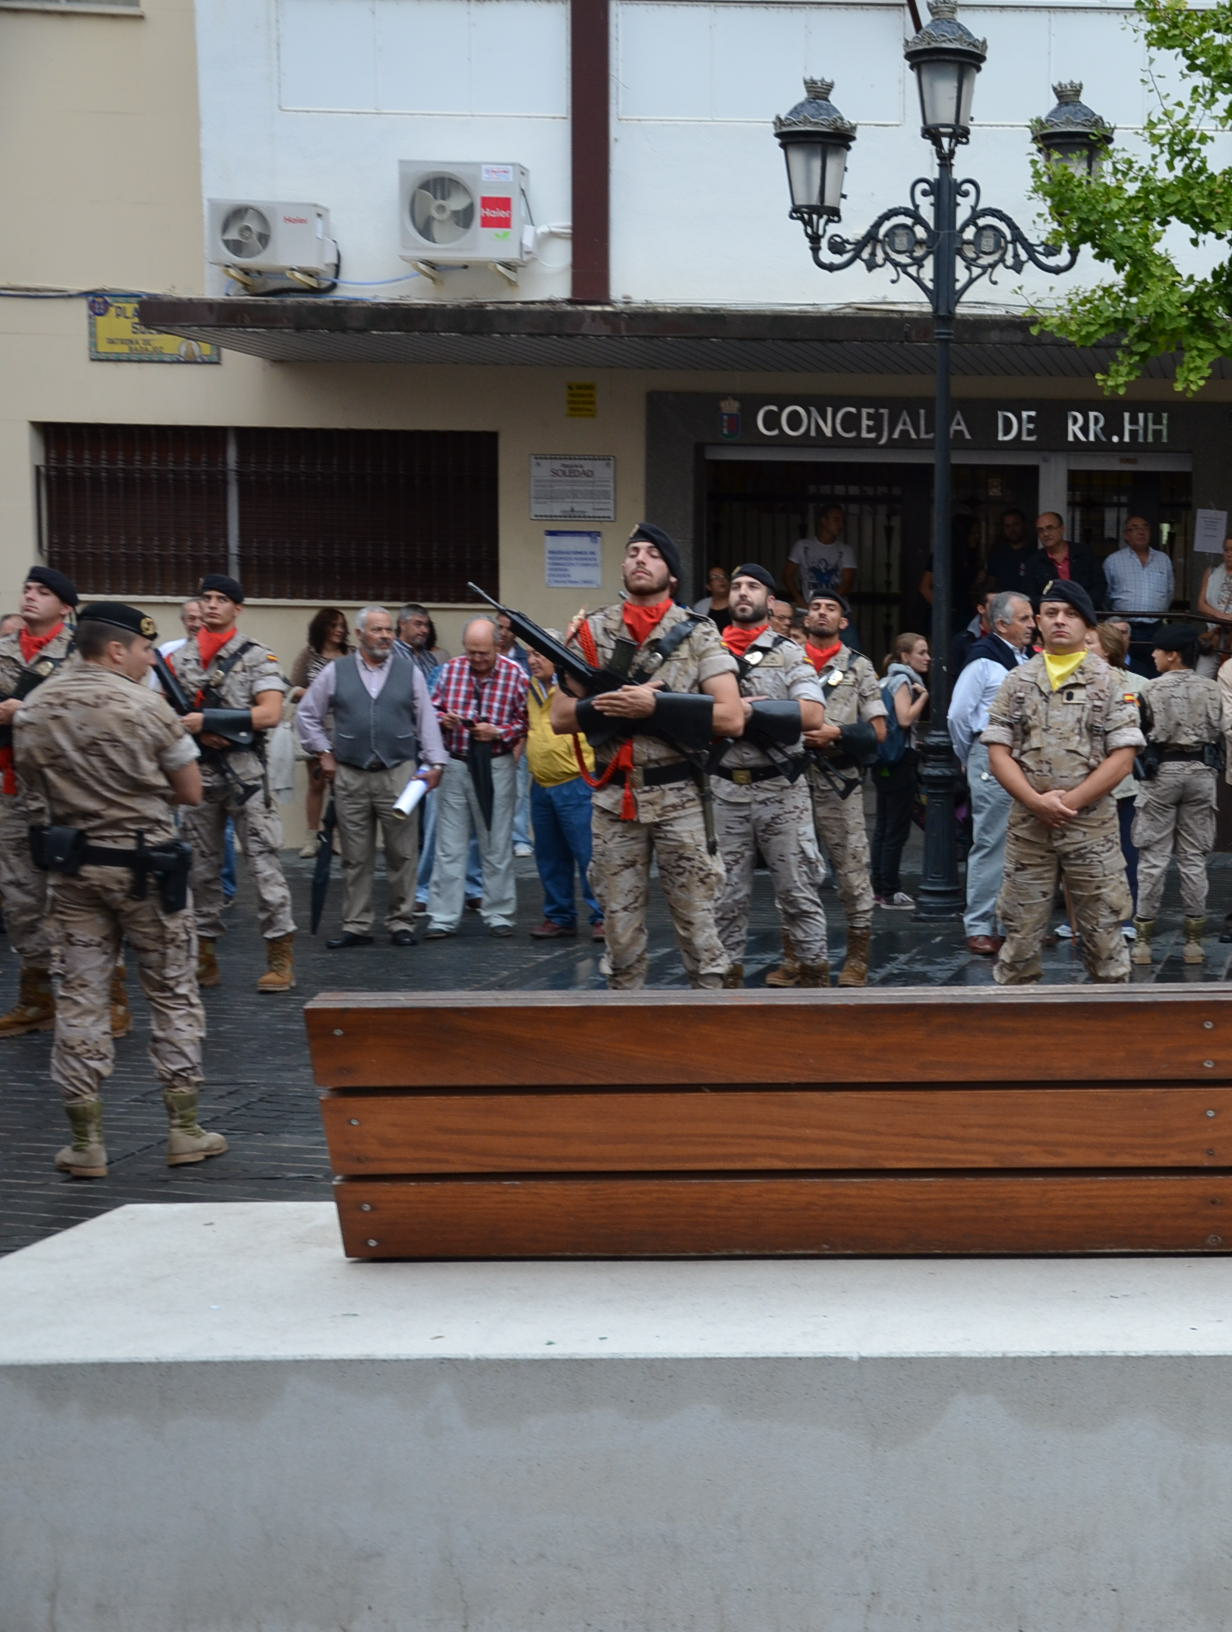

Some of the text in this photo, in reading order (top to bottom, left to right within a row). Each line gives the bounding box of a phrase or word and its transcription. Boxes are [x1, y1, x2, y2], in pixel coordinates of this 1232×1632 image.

[481, 207, 512, 218] Haier
[757, 405, 1168, 445] CONCEJALA DE RR.HH
[550, 467, 594, 478] SOLEDAD
